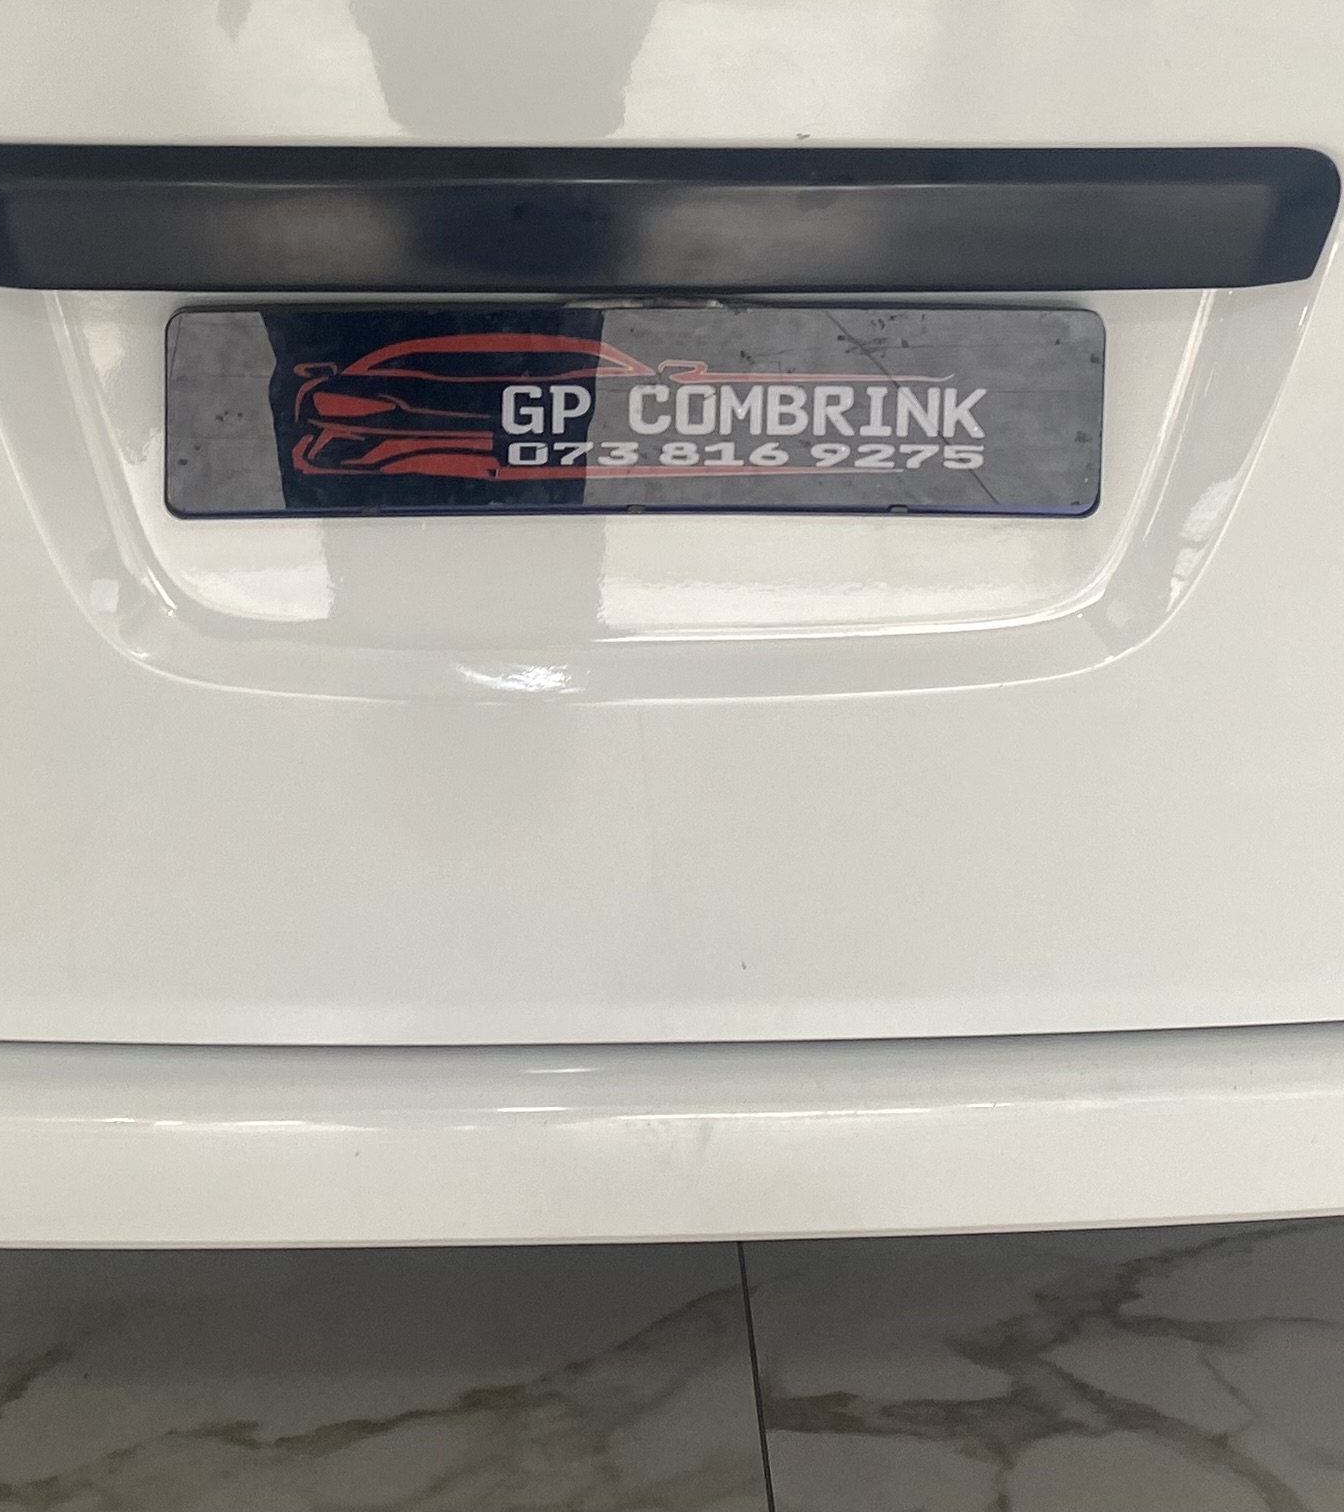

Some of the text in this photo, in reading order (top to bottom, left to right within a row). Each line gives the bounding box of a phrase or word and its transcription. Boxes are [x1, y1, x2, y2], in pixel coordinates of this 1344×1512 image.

[501, 384, 988, 439] GP COMBRINK
[507, 441, 986, 470] 073 816 9275
